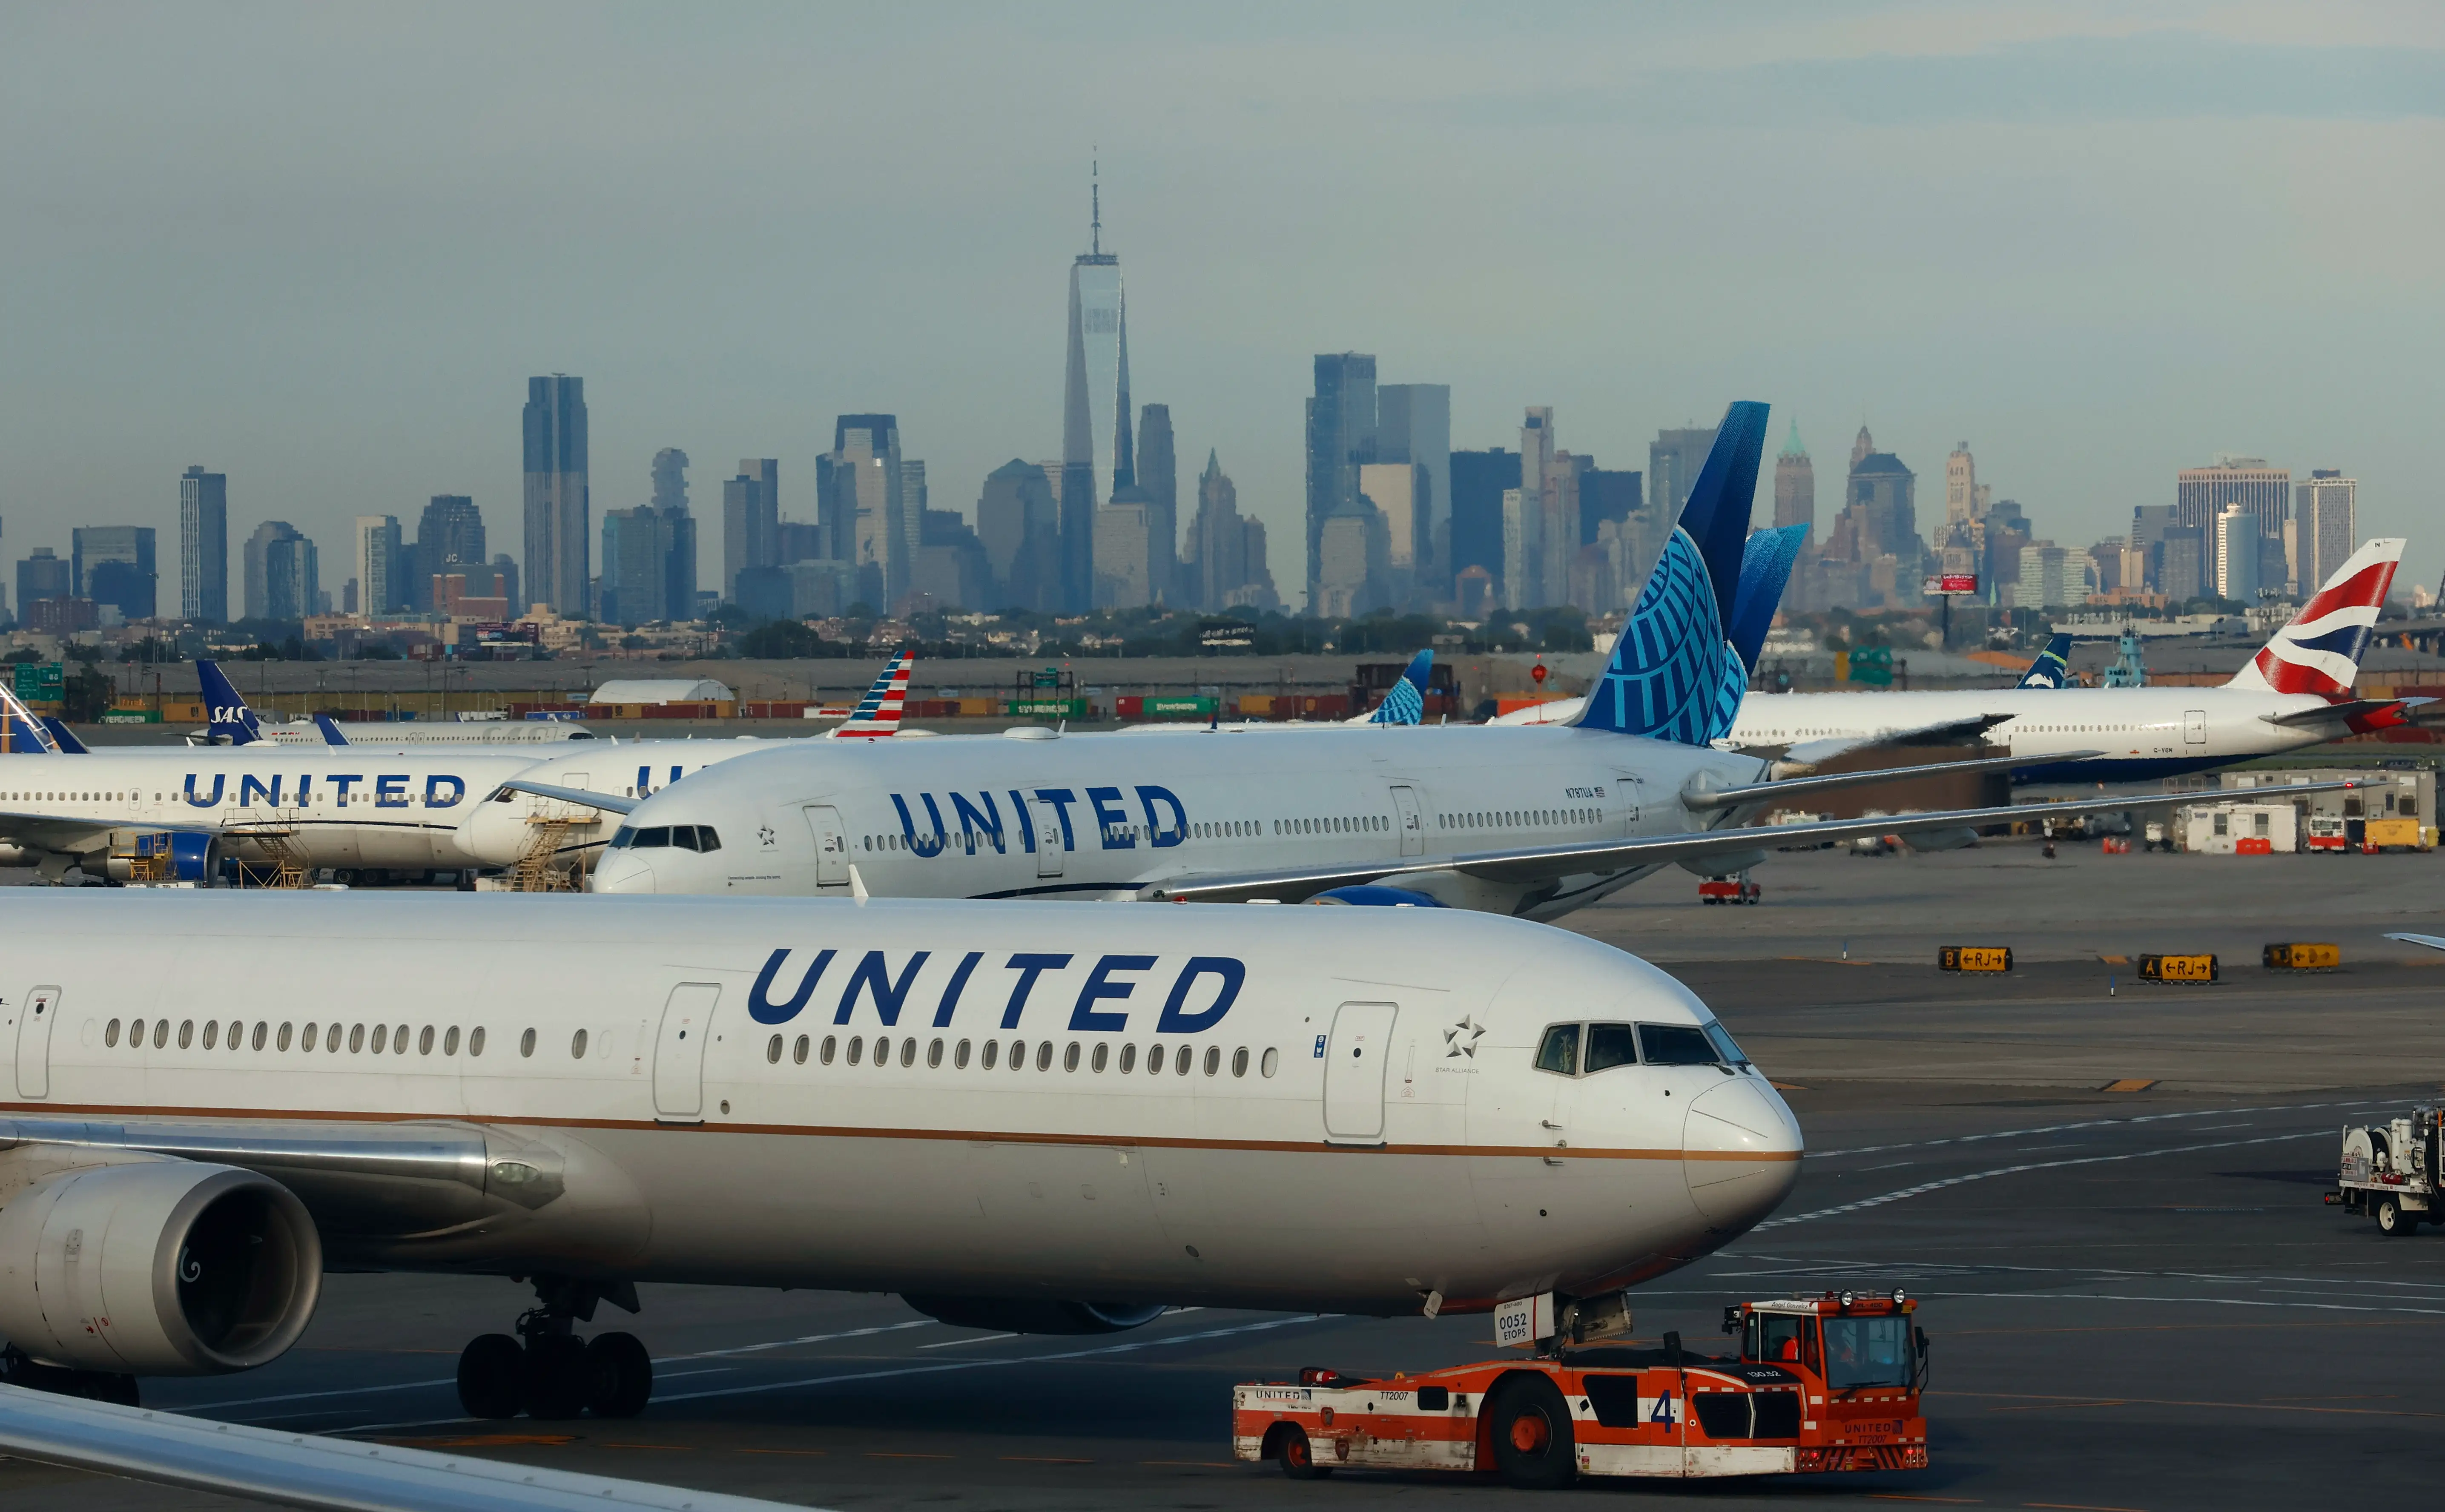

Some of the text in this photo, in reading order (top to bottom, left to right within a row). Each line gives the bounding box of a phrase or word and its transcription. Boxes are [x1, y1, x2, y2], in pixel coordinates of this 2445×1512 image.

[210, 706, 248, 723] SAS
[184, 774, 465, 809] UNITED
[1566, 787, 1594, 799] N787UA
[890, 785, 1188, 858] UNITED
[1946, 952, 1954, 966] B
[1975, 953, 1991, 966] RJ
[2146, 959, 2155, 975] A
[2178, 960, 2195, 975] RJ
[748, 949, 1245, 1033] UNITED
[1500, 1313, 1527, 1329] 0052
[1504, 1328, 1526, 1340] ETOPS
[1257, 1390, 1300, 1400] UNITED
[1380, 1391, 1408, 1400] TT2007
[1651, 1389, 1675, 1434] 4
[1845, 1423, 1891, 1434] UNITED
[1858, 1435, 1887, 1444] TT2007
